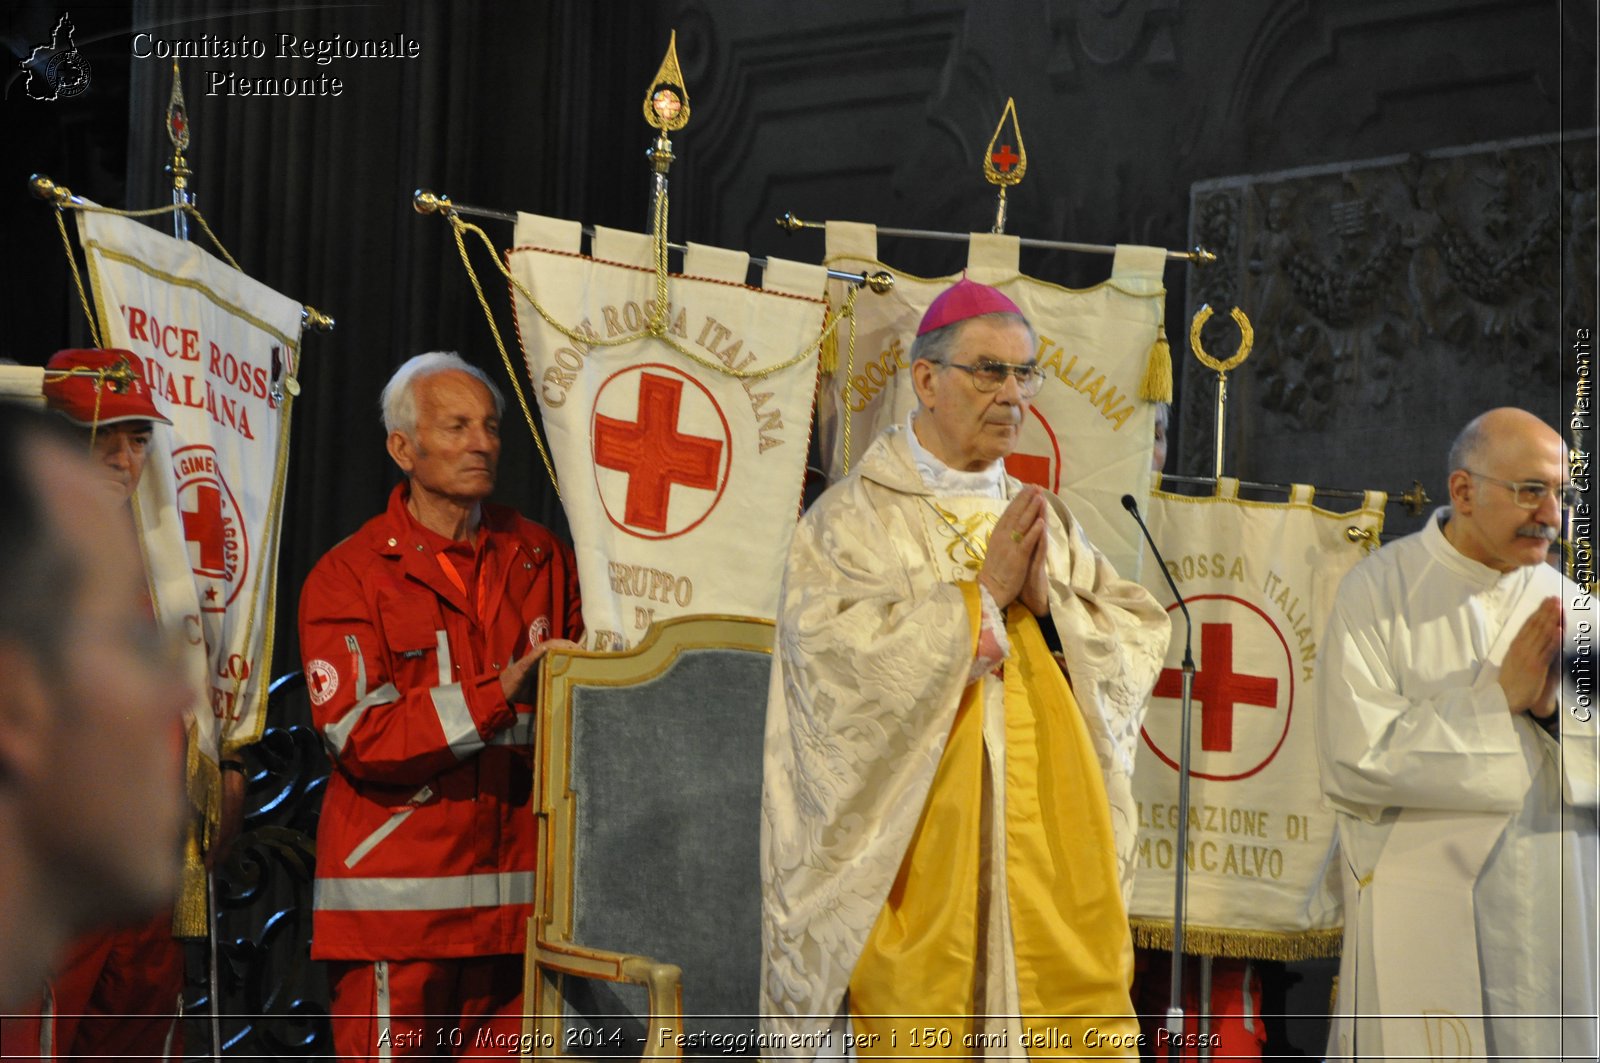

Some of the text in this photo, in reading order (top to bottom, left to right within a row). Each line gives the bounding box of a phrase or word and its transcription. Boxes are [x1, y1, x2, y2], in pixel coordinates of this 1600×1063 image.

[120, 304, 201, 362] ROCE
[841, 338, 911, 414] CROCE
[1263, 569, 1318, 684] ITALIANA
[1285, 813, 1309, 841] DI
